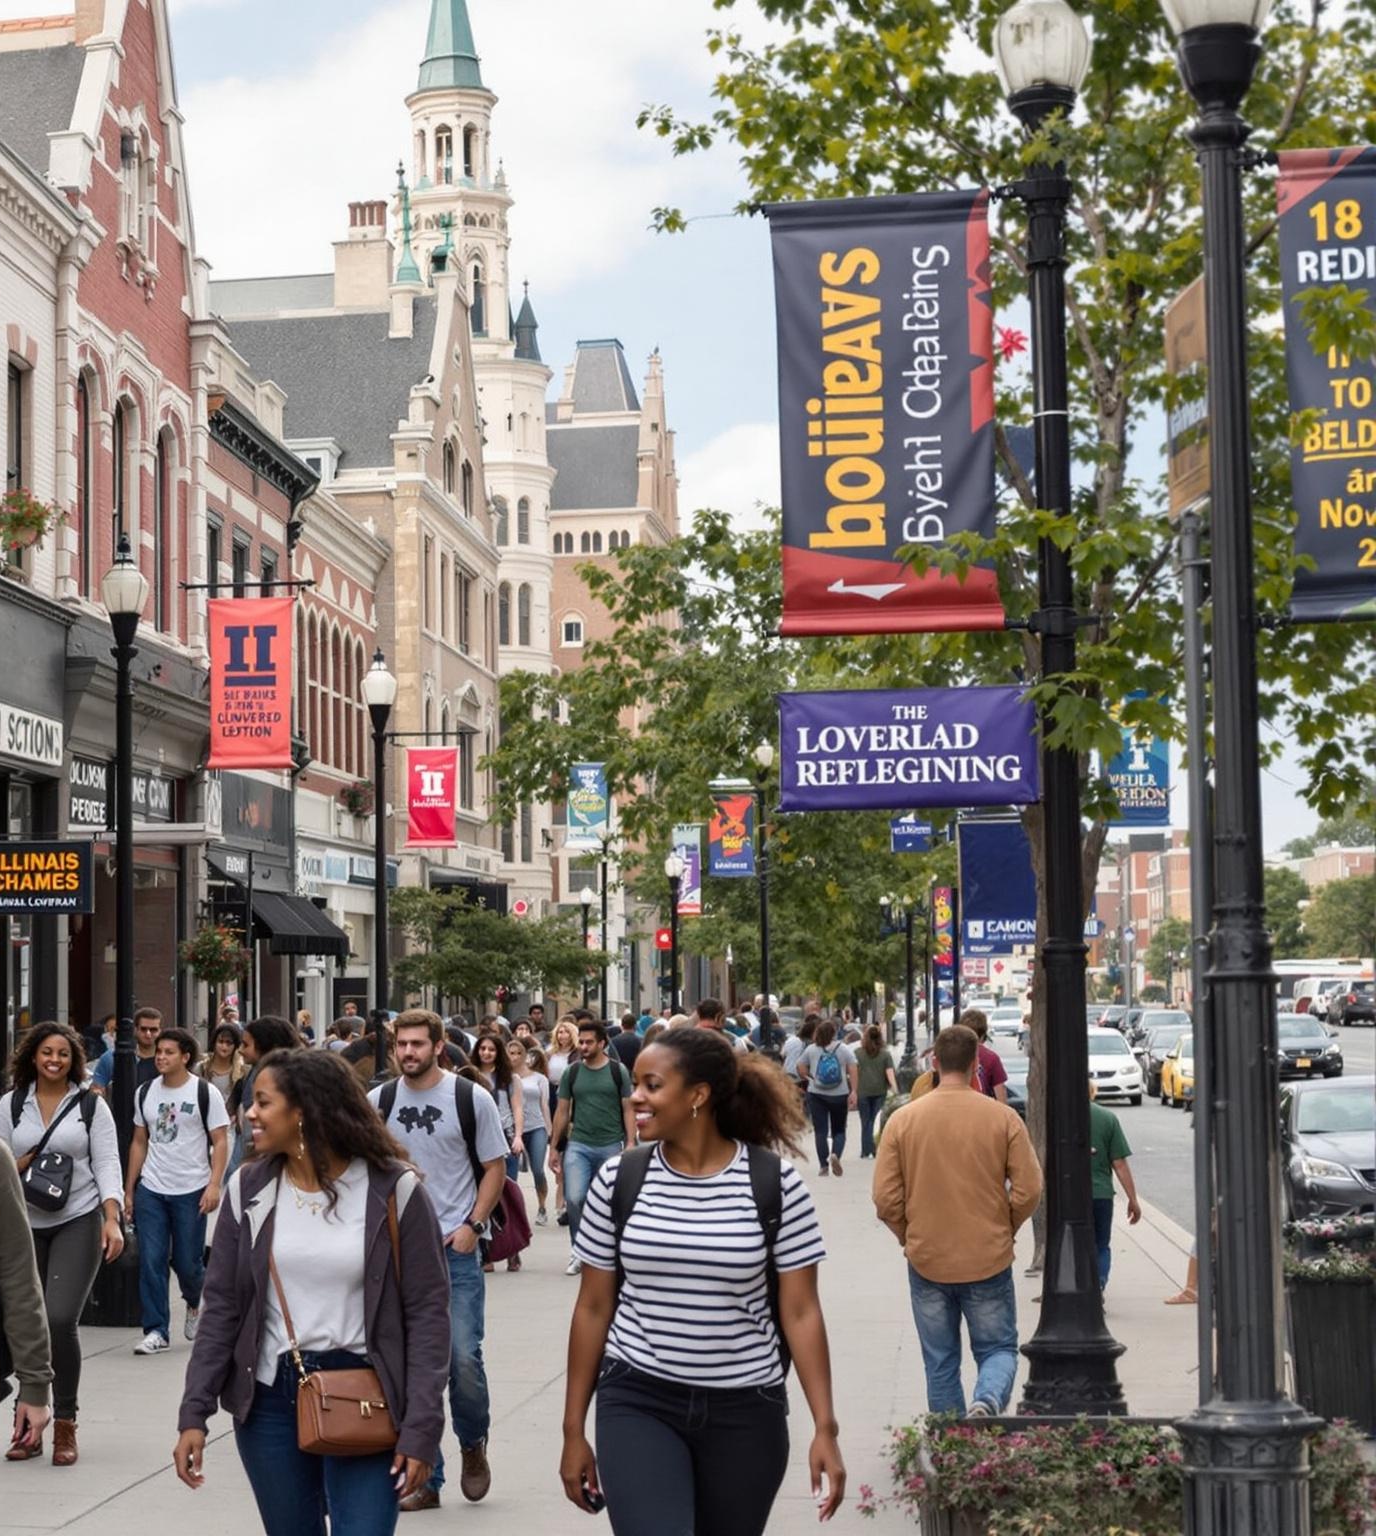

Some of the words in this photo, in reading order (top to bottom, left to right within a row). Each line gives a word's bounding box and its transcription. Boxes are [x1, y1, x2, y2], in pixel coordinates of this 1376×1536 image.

[1309, 199, 1363, 241] 18
[1330, 377, 1372, 409] TO
[892, 705, 928, 720] THE
[797, 723, 979, 754] LOVERLAD
[796, 754, 1022, 787] REFLEGINING
